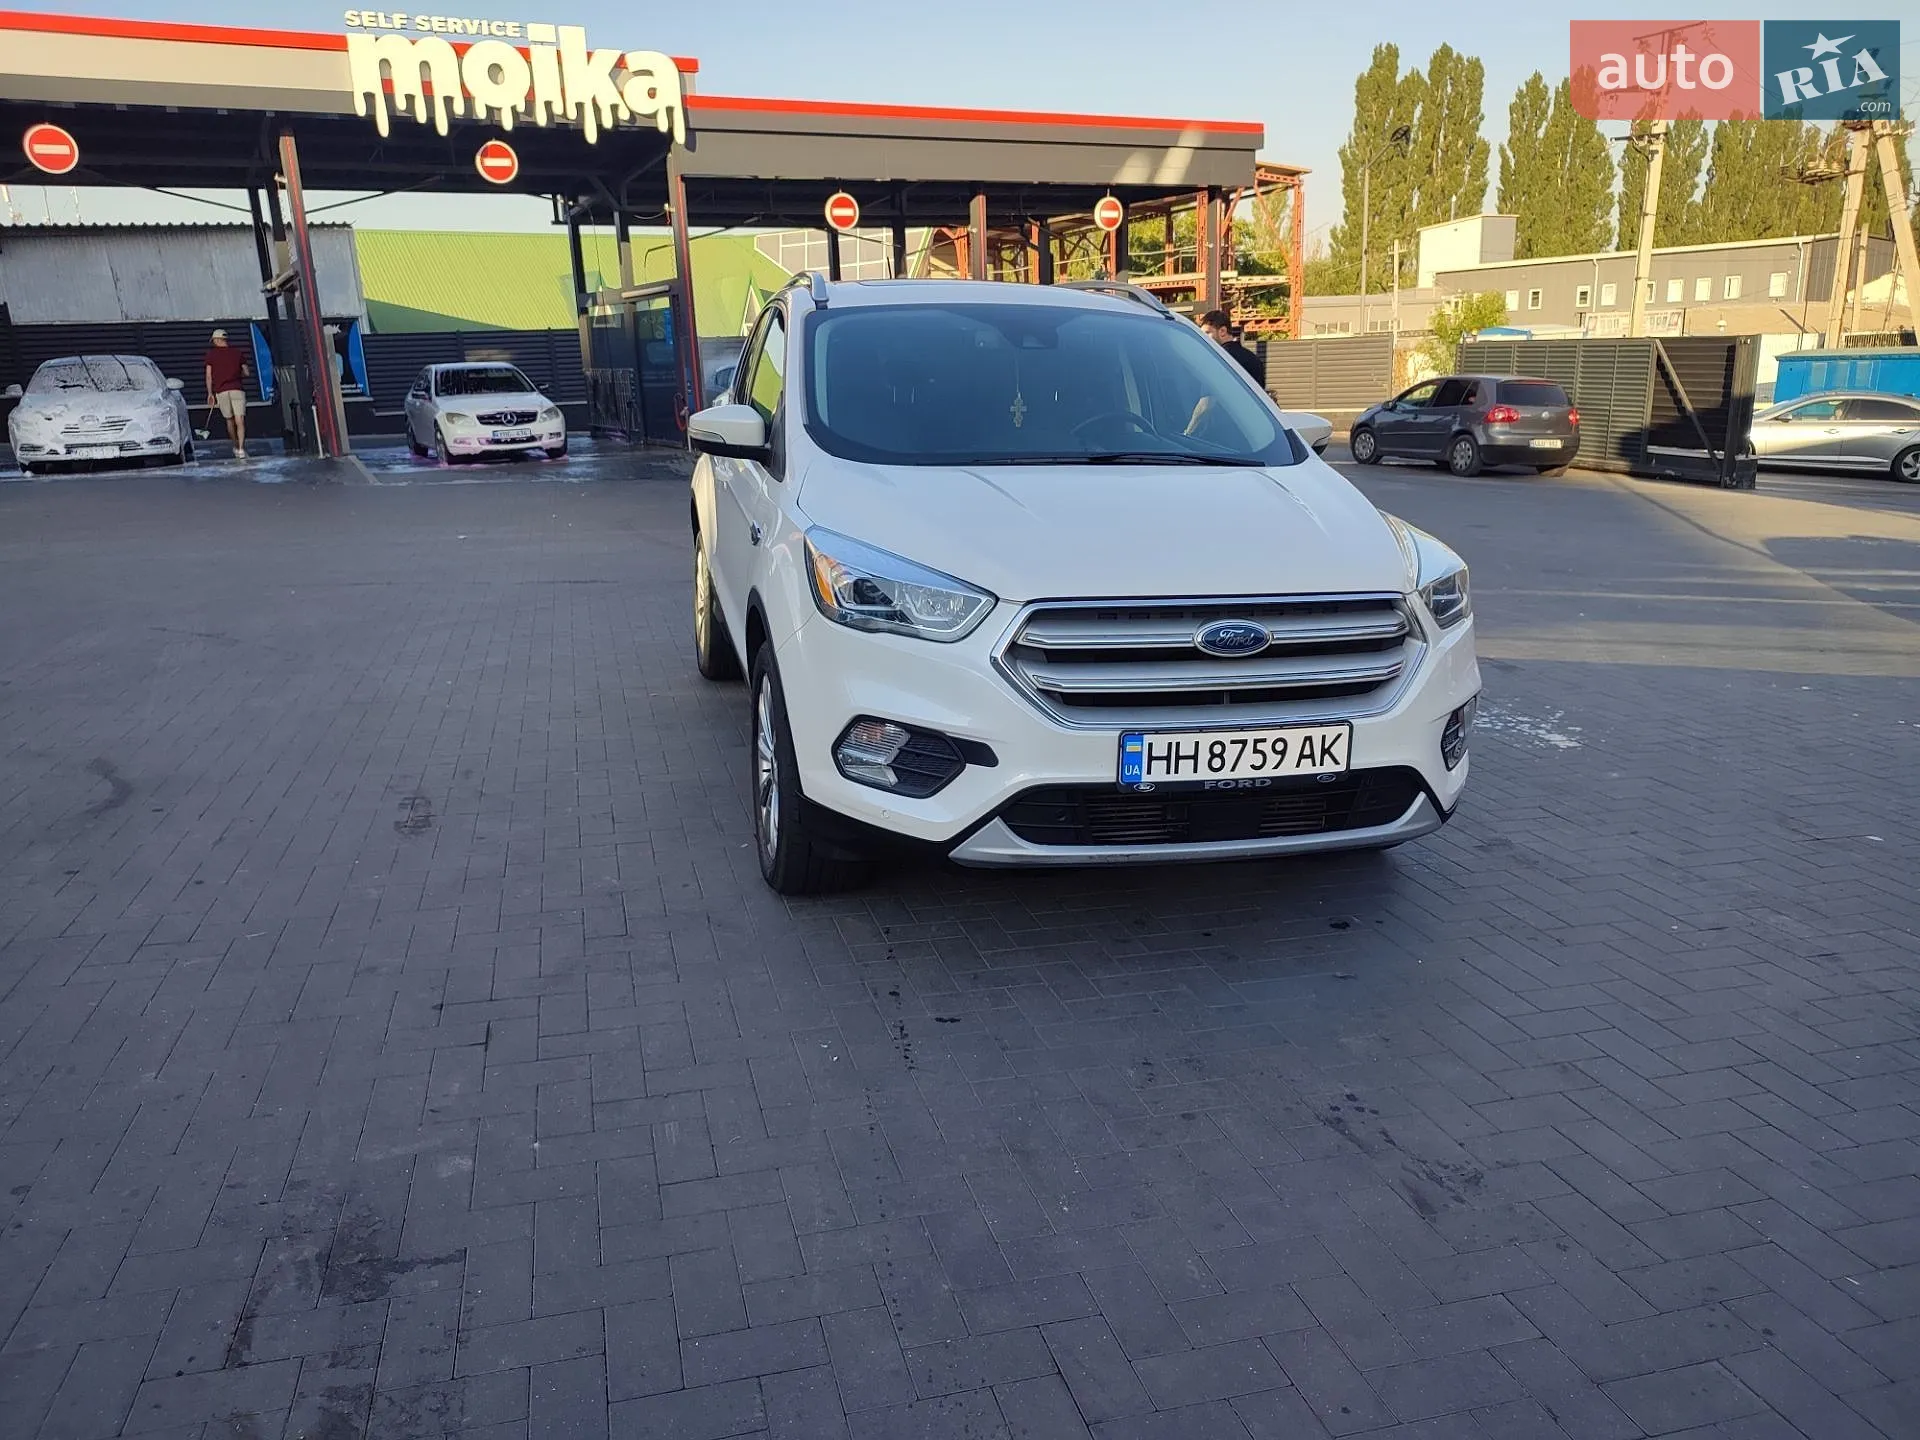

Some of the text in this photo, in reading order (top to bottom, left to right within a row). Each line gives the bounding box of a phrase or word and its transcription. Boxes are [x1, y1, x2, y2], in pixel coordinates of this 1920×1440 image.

[344, 10, 521, 38] SELF SERVICE
[346, 24, 686, 145] moika
[1216, 629, 1255, 646] Ford
[1146, 732, 1343, 775] HH 8759 AK
[1124, 764, 1141, 776] UA
[1204, 778, 1272, 790] FORD
